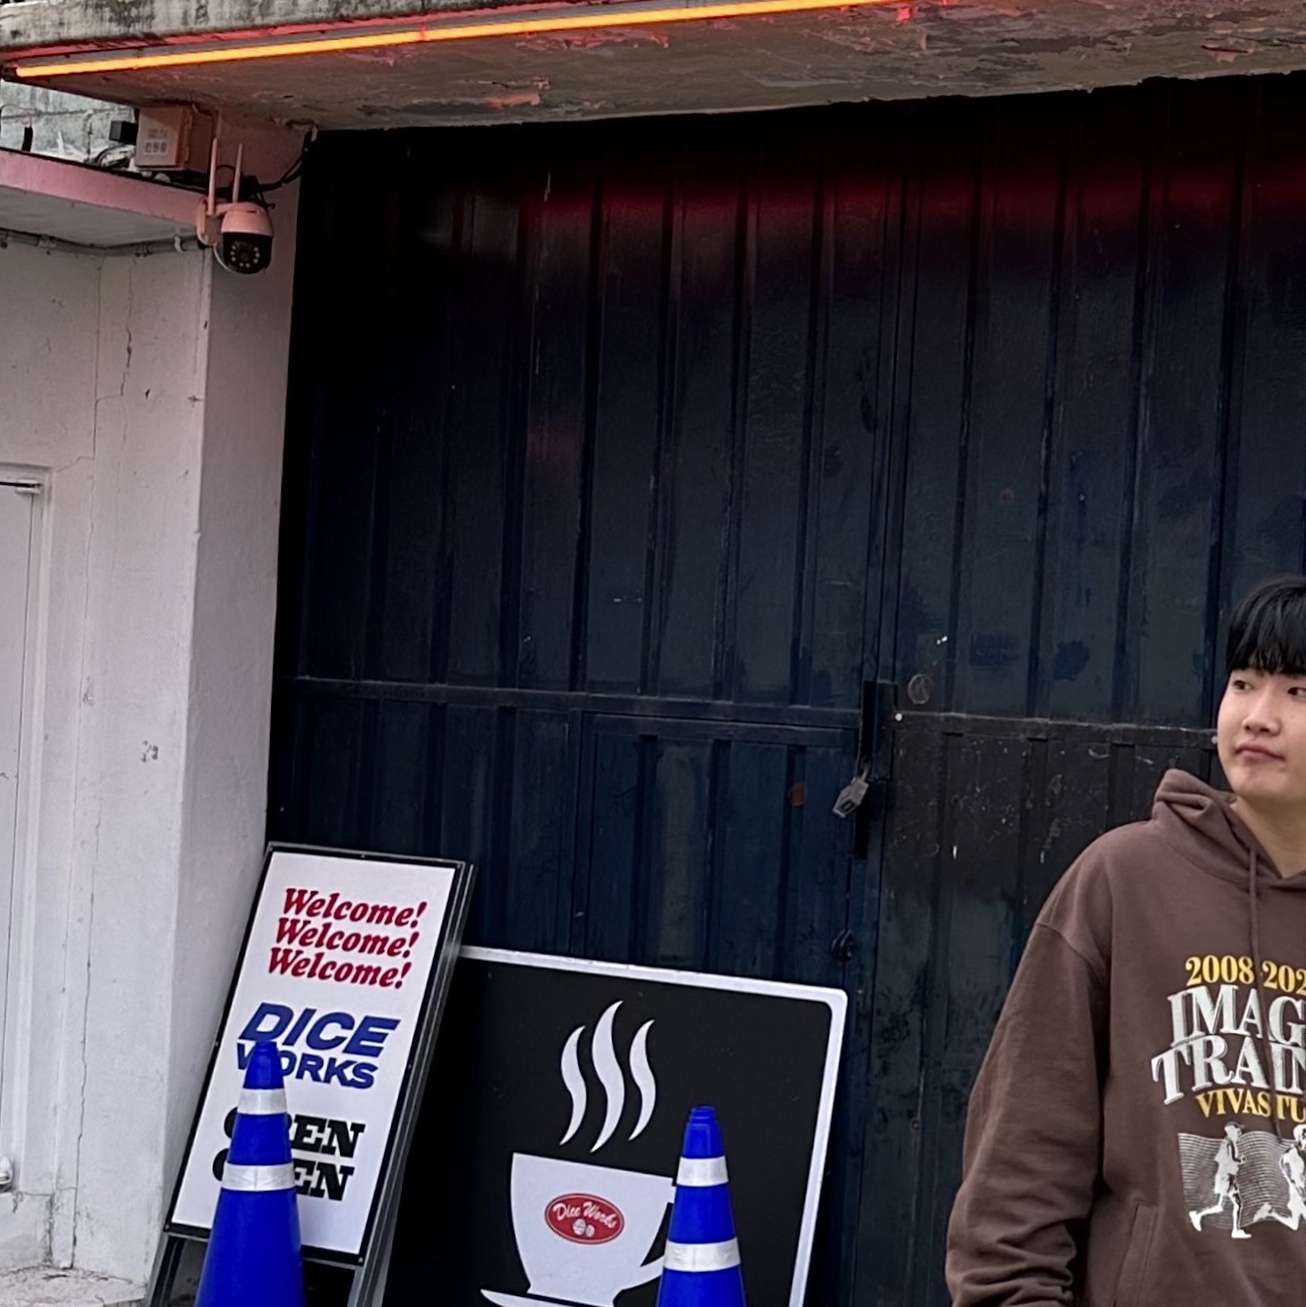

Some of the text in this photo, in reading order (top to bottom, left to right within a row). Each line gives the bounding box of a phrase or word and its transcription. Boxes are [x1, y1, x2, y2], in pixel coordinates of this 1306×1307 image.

[283, 888, 428, 929] Welcome!
[276, 917, 420, 959] Welcome!
[268, 947, 412, 989] Welcome!
[1185, 955, 1254, 986] 2008
[238, 1002, 402, 1058] DICE
[223, 1106, 366, 1158] EN
[212, 1147, 355, 1201] EN
[553, 1201, 617, 1228] Dice Works
